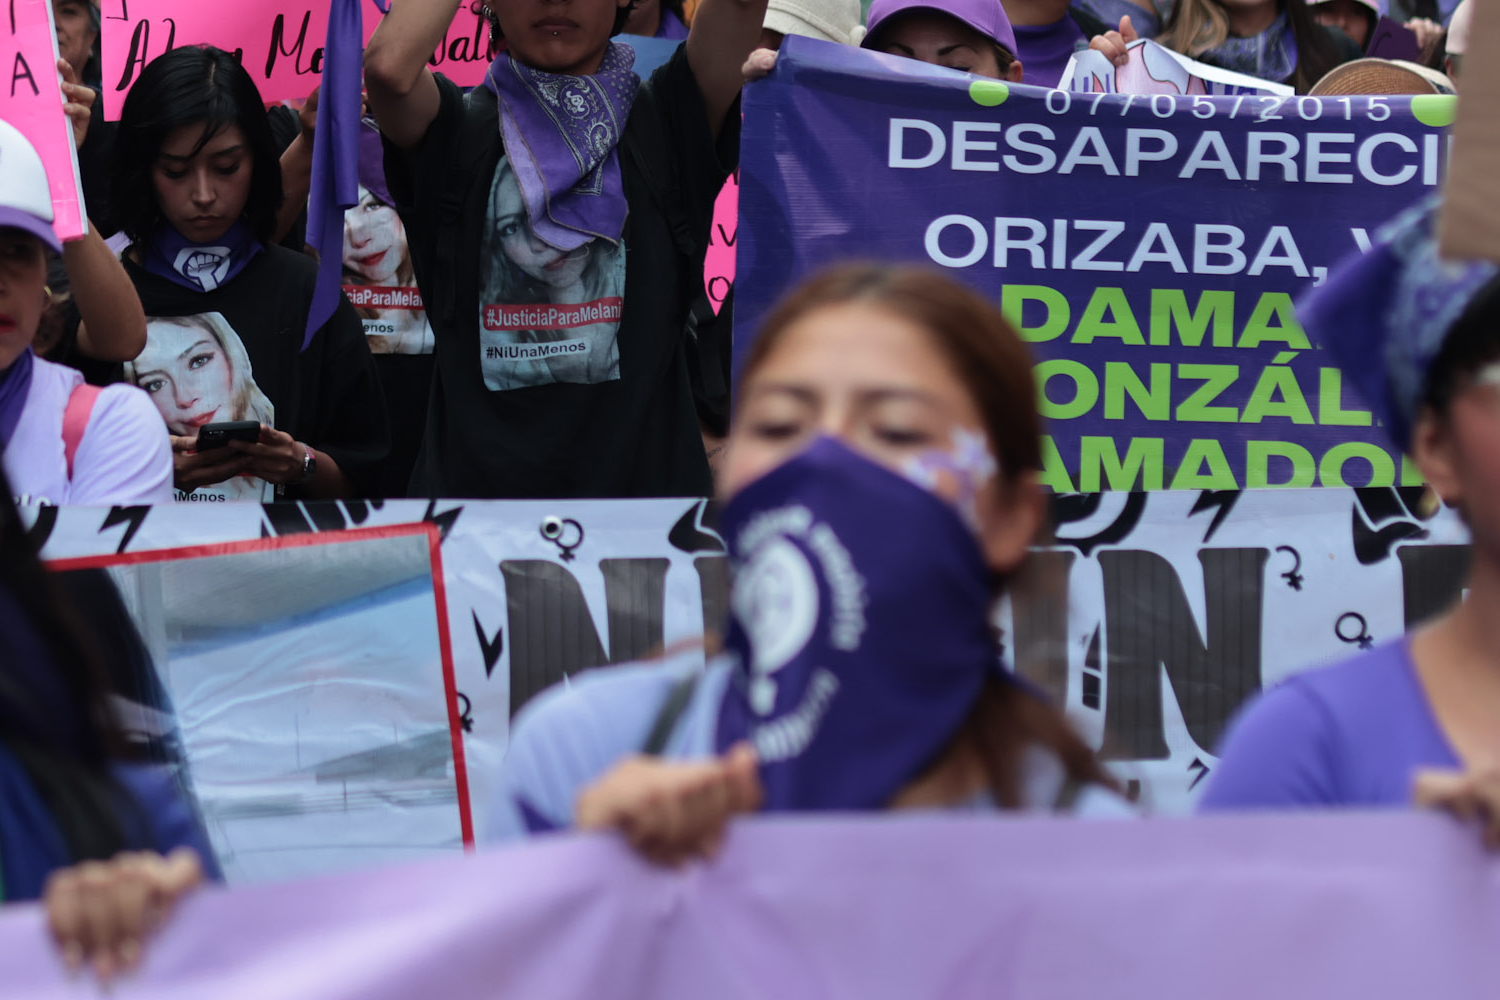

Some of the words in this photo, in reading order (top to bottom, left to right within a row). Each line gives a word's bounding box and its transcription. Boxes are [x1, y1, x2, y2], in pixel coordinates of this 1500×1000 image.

[1045, 88, 1392, 123] 07/05/2015
[888, 117, 1453, 187] DESAPARECI
[924, 214, 1329, 288] ORIZABA,
[486, 301, 622, 327] #JusticiaParaMelani
[1000, 284, 1324, 351] DAMA
[486, 341, 587, 359] #NiUnaMenos
[1034, 351, 1384, 428] ONZÁL
